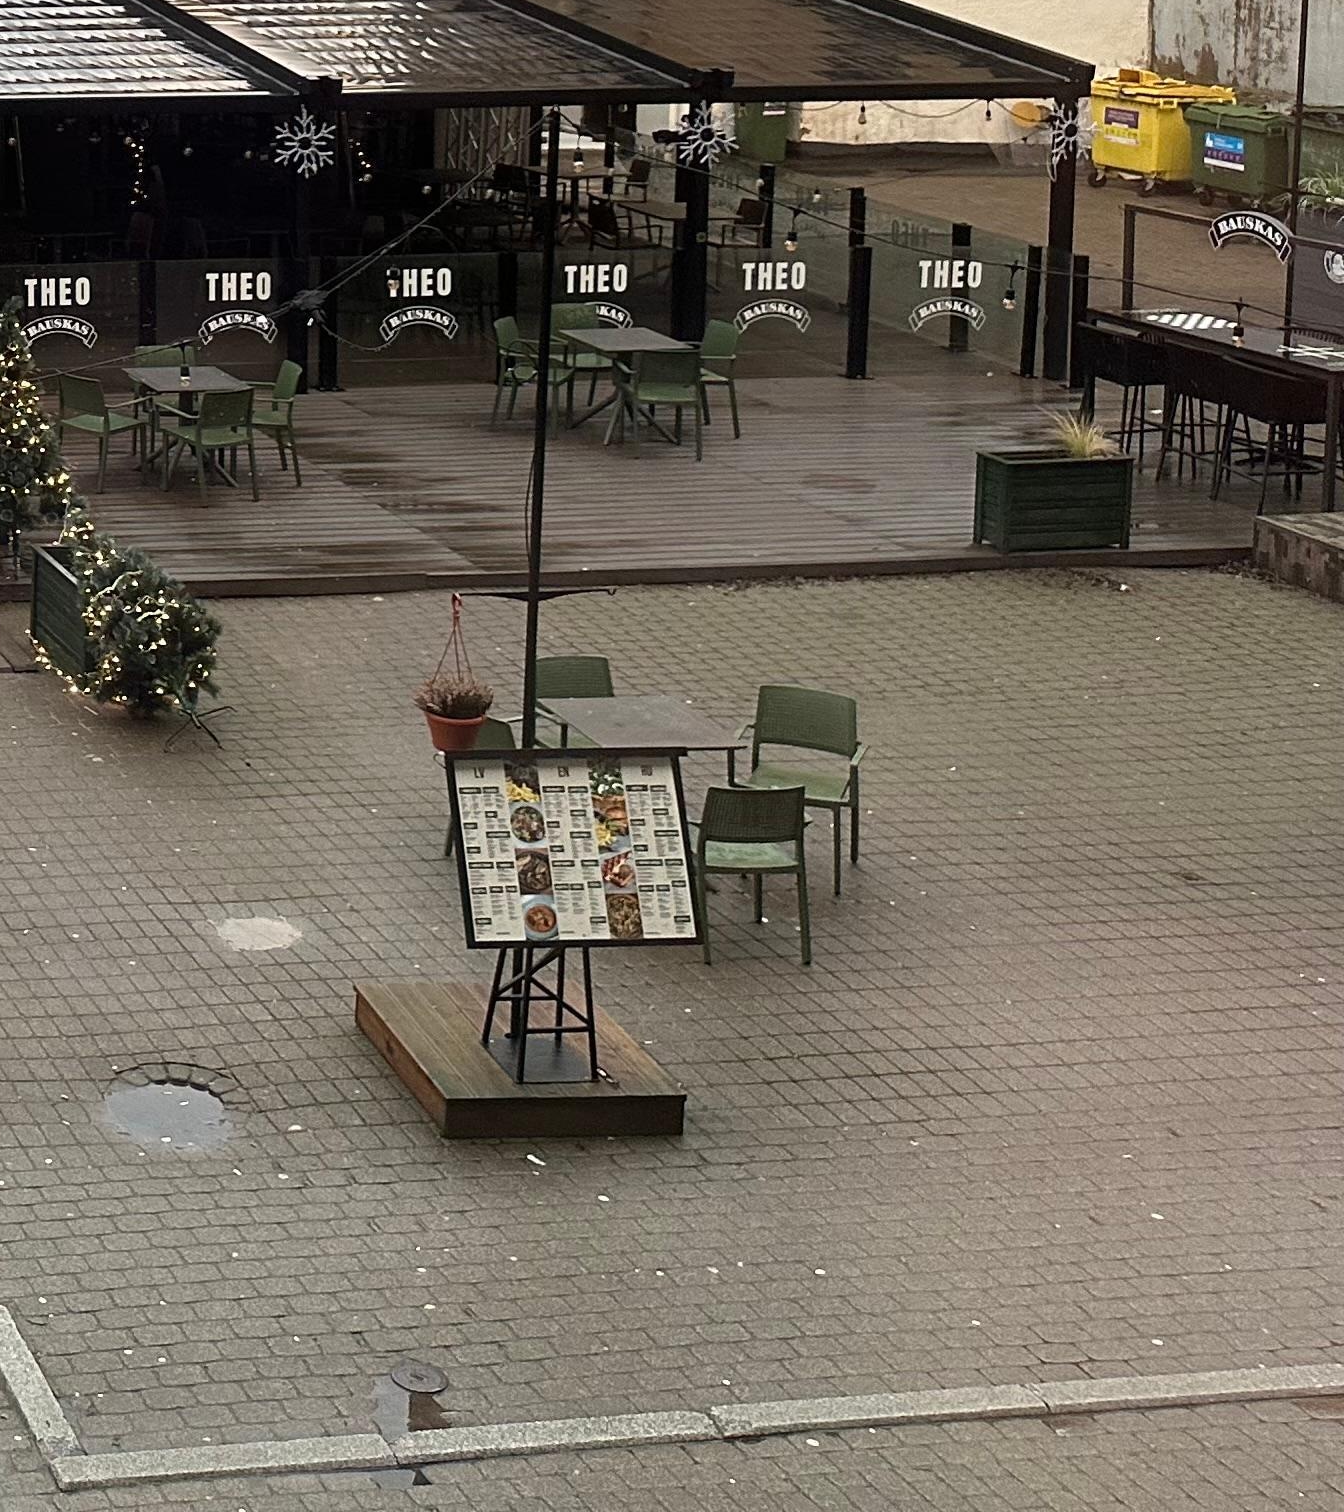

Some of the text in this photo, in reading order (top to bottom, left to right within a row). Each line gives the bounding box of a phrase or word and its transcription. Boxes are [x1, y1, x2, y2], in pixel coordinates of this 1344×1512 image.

[1217, 216, 1284, 246] BAUSKAS
[205, 271, 272, 301] THEO
[564, 263, 628, 294] THEO
[742, 261, 806, 291] THEO
[918, 259, 983, 289] THEO
[24, 276, 91, 307] THEO
[208, 313, 270, 332] BAUSKS
[389, 309, 451, 328] BAUSKAS
[743, 302, 803, 321] BAUSKAS
[918, 300, 979, 318] BAUSKAS
[27, 318, 90, 337] BAUSKAS
